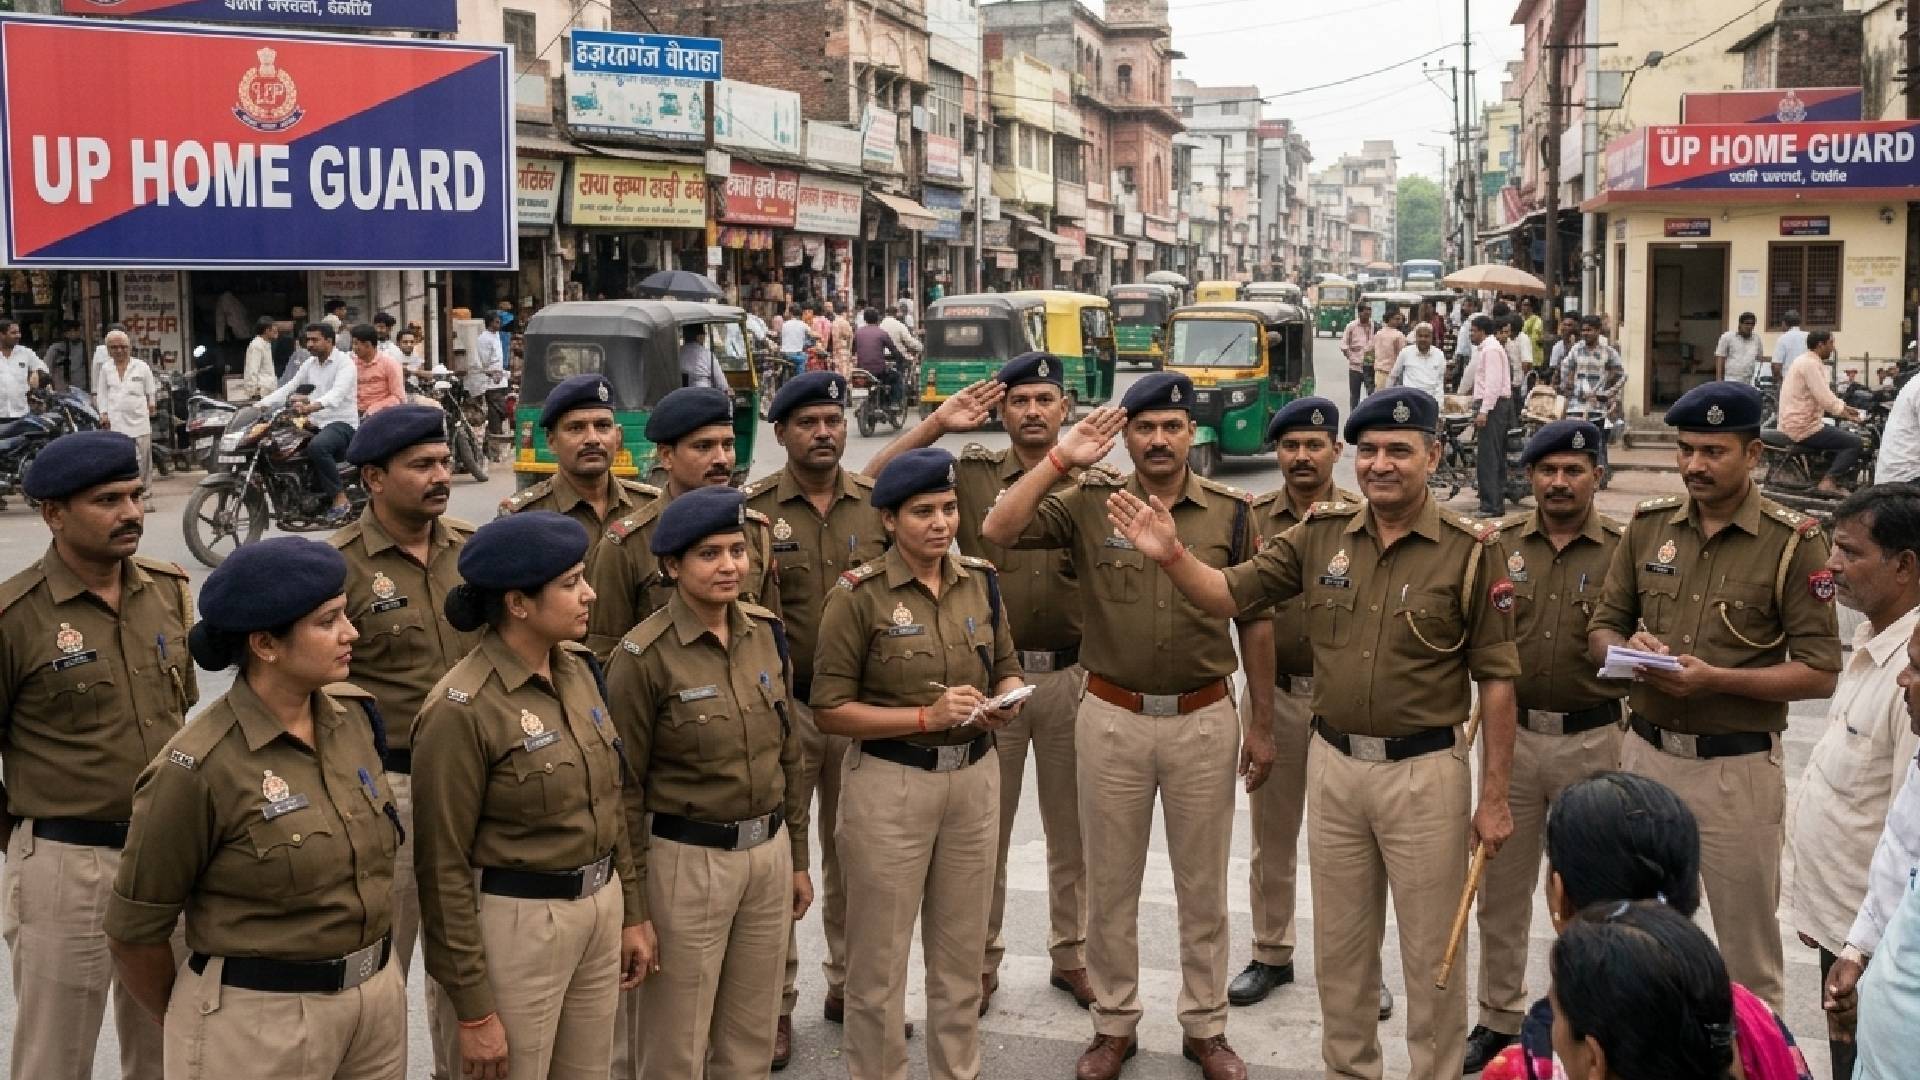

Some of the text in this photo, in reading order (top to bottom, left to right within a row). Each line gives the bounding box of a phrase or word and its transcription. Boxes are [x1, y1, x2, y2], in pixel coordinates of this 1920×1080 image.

[32, 135, 111, 205] UP
[131, 138, 293, 208] HOME
[309, 144, 486, 211] GUARD
[1661, 136, 1700, 166] UP
[1710, 134, 1798, 165] HOME
[1807, 132, 1915, 164] GUARD
